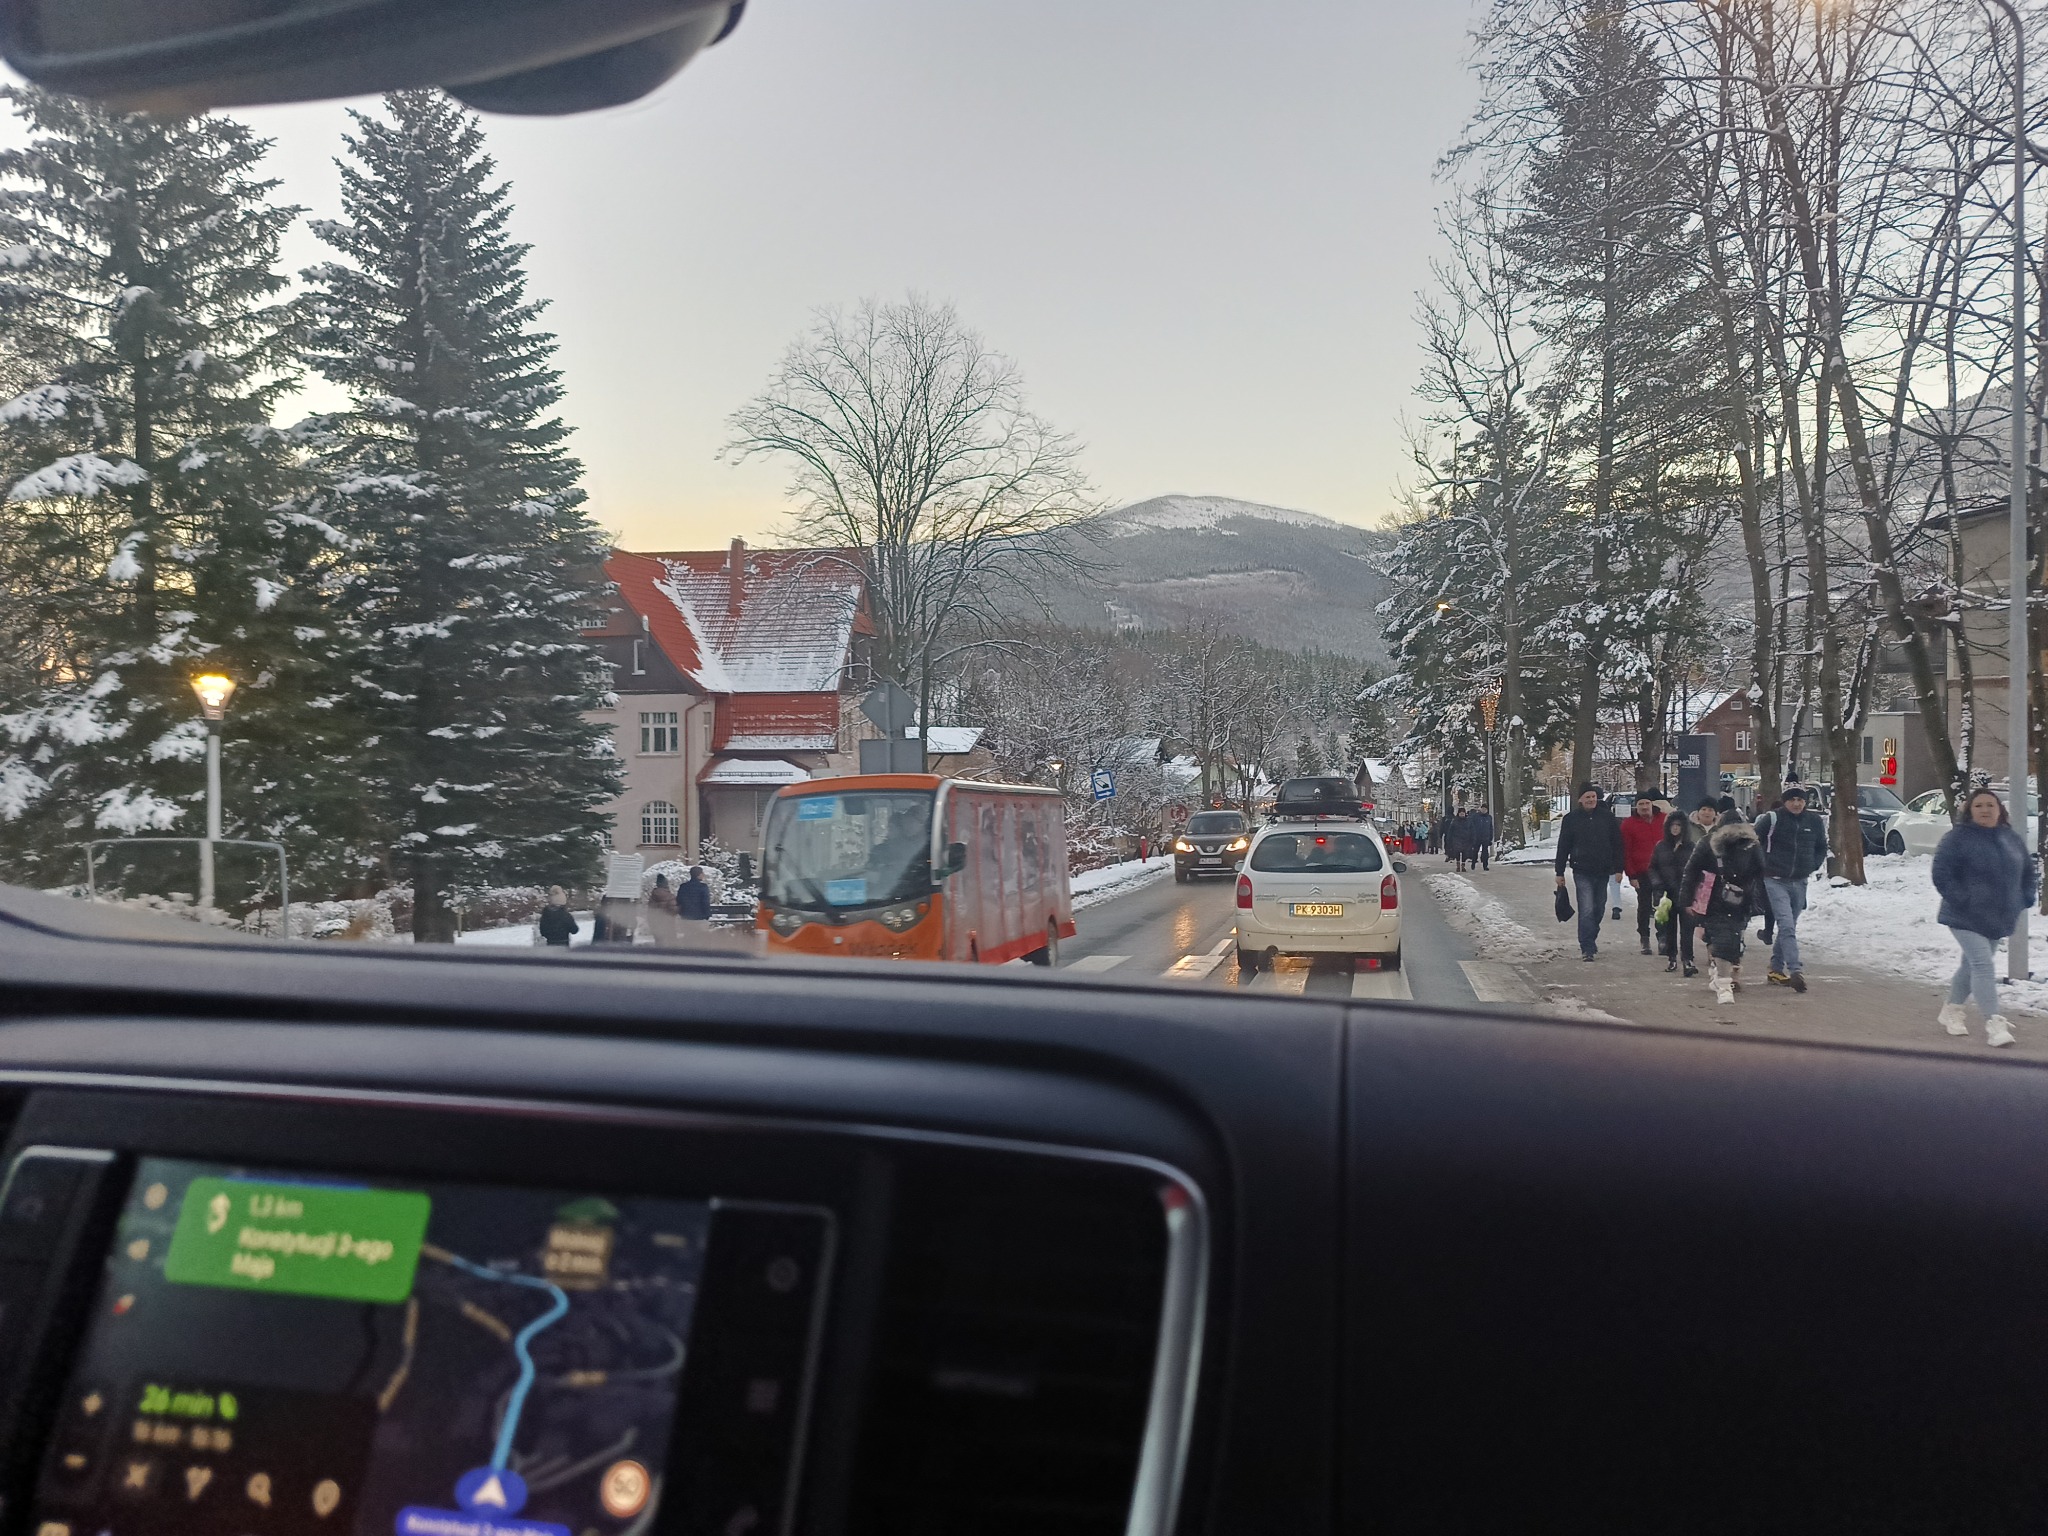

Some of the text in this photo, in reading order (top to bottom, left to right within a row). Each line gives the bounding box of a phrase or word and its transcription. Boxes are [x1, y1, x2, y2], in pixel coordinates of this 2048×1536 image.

[1883, 737, 1897, 756] GU
[1880, 757, 1897, 776] STO
[1295, 905, 1341, 915] PK 9303H
